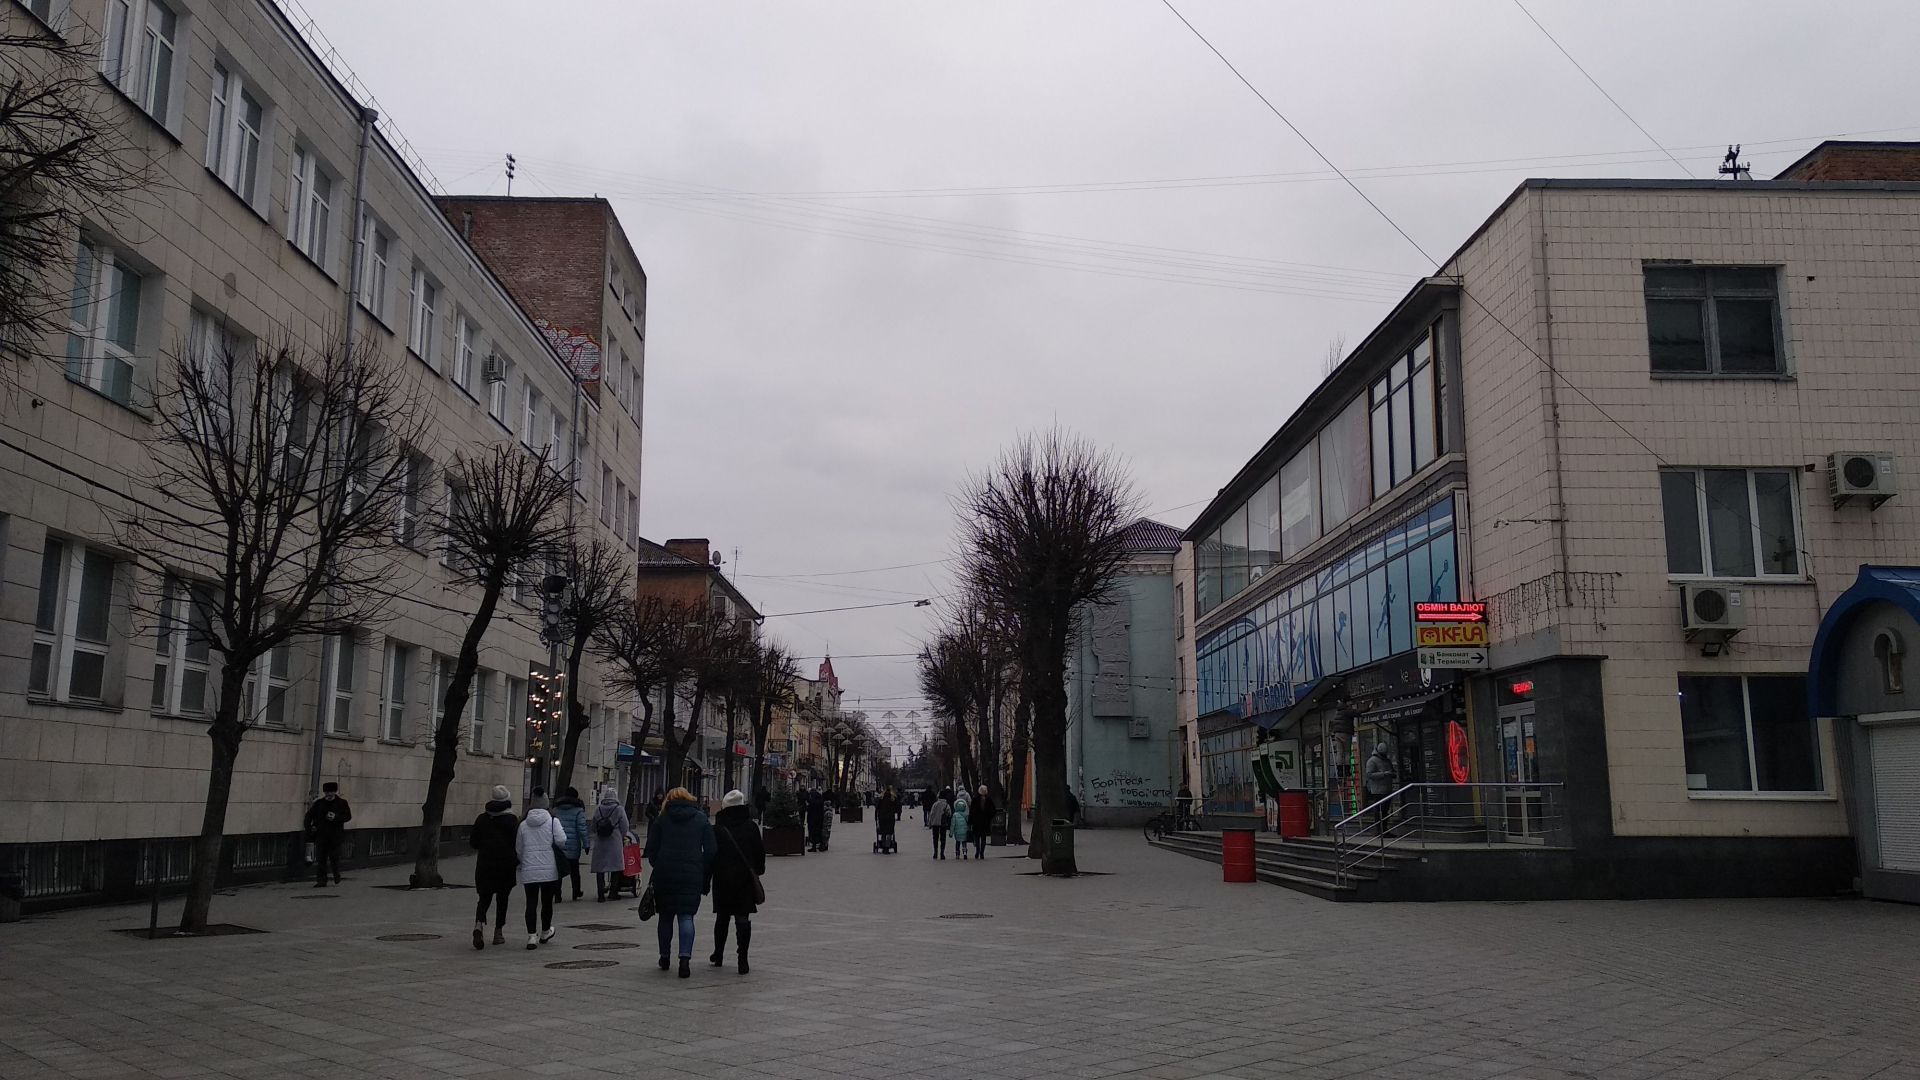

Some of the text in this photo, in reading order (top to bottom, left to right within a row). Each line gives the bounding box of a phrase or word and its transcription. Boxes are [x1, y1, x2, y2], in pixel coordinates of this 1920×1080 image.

[1417, 603, 1485, 612] ОБМІН ВАЛЮТ
[1441, 626, 1484, 642] KF.UA
